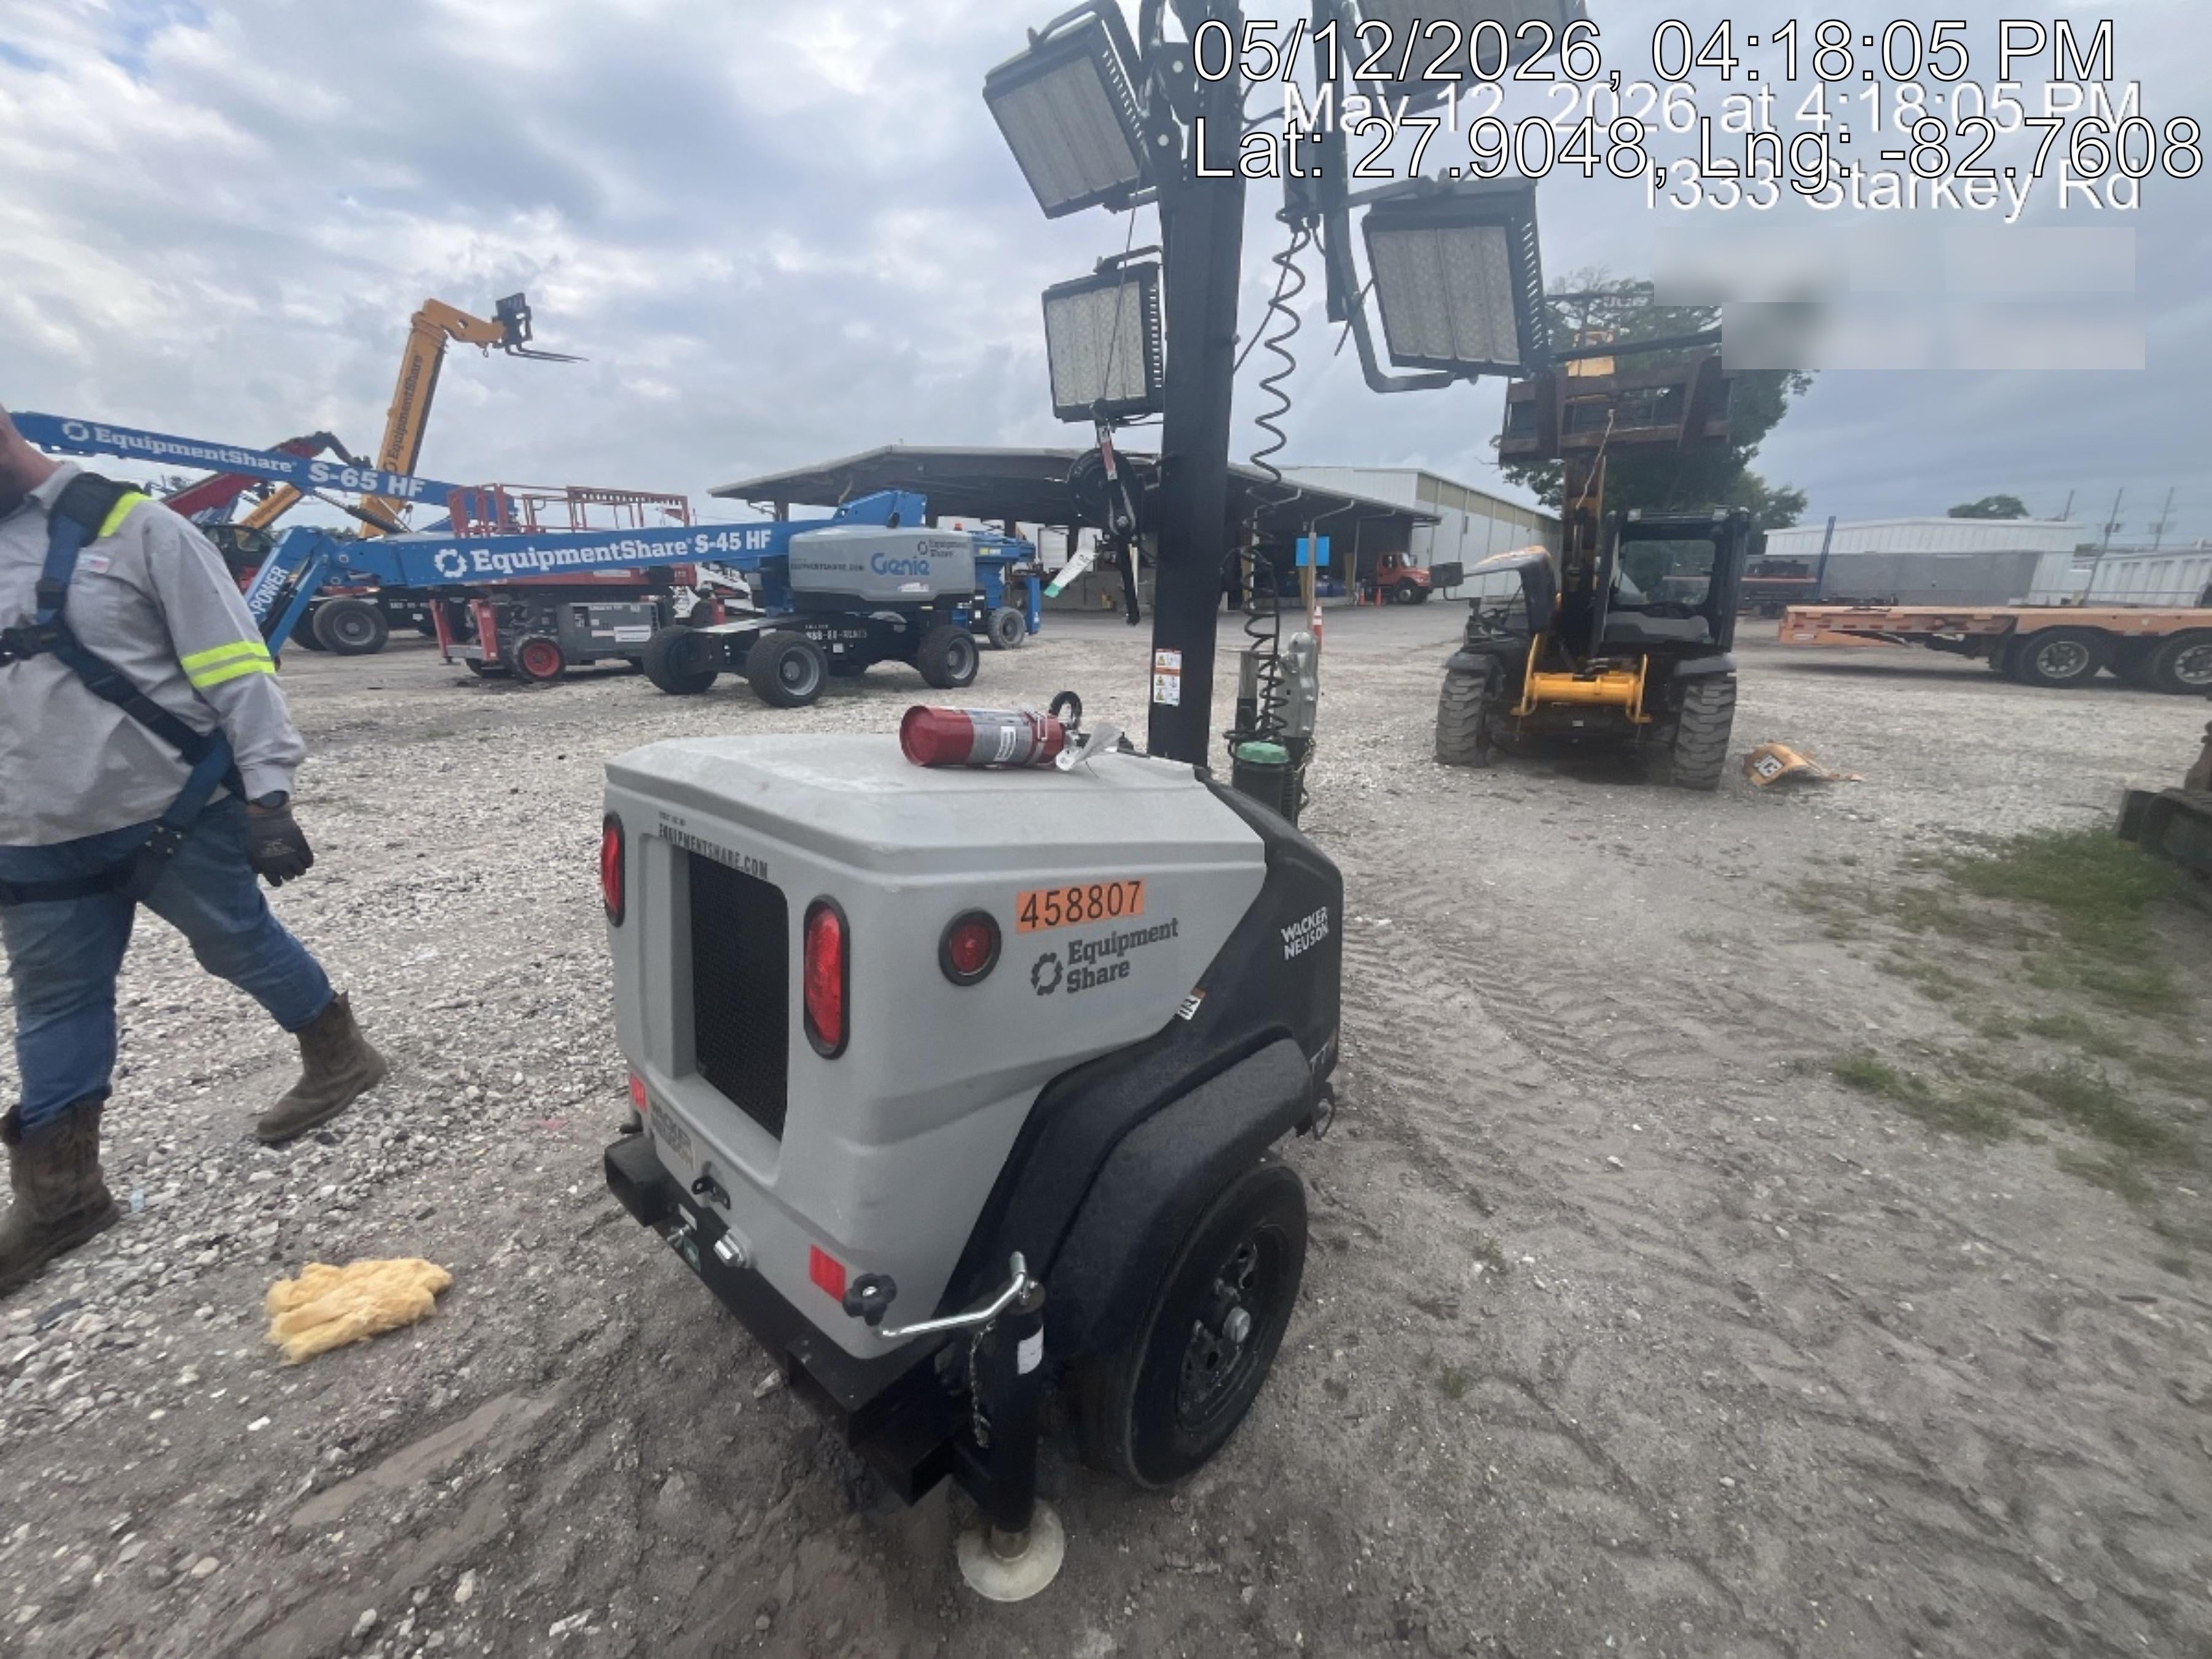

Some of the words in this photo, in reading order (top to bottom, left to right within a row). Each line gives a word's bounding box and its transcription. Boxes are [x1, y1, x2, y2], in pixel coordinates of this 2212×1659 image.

[309, 463, 378, 491] S-65
[387, 474, 426, 498] HF
[694, 533, 742, 553] S-45
[745, 530, 772, 549] HF
[870, 552, 930, 576] Genie
[659, 823, 767, 880] EQUIPMENTSHARE.COM
[1020, 880, 1141, 928] 458807
[1067, 917, 1179, 965] Equipment
[1281, 906, 1328, 943] WACKER
[1284, 923, 1329, 960] NEUSON
[1067, 960, 1131, 994] Share
